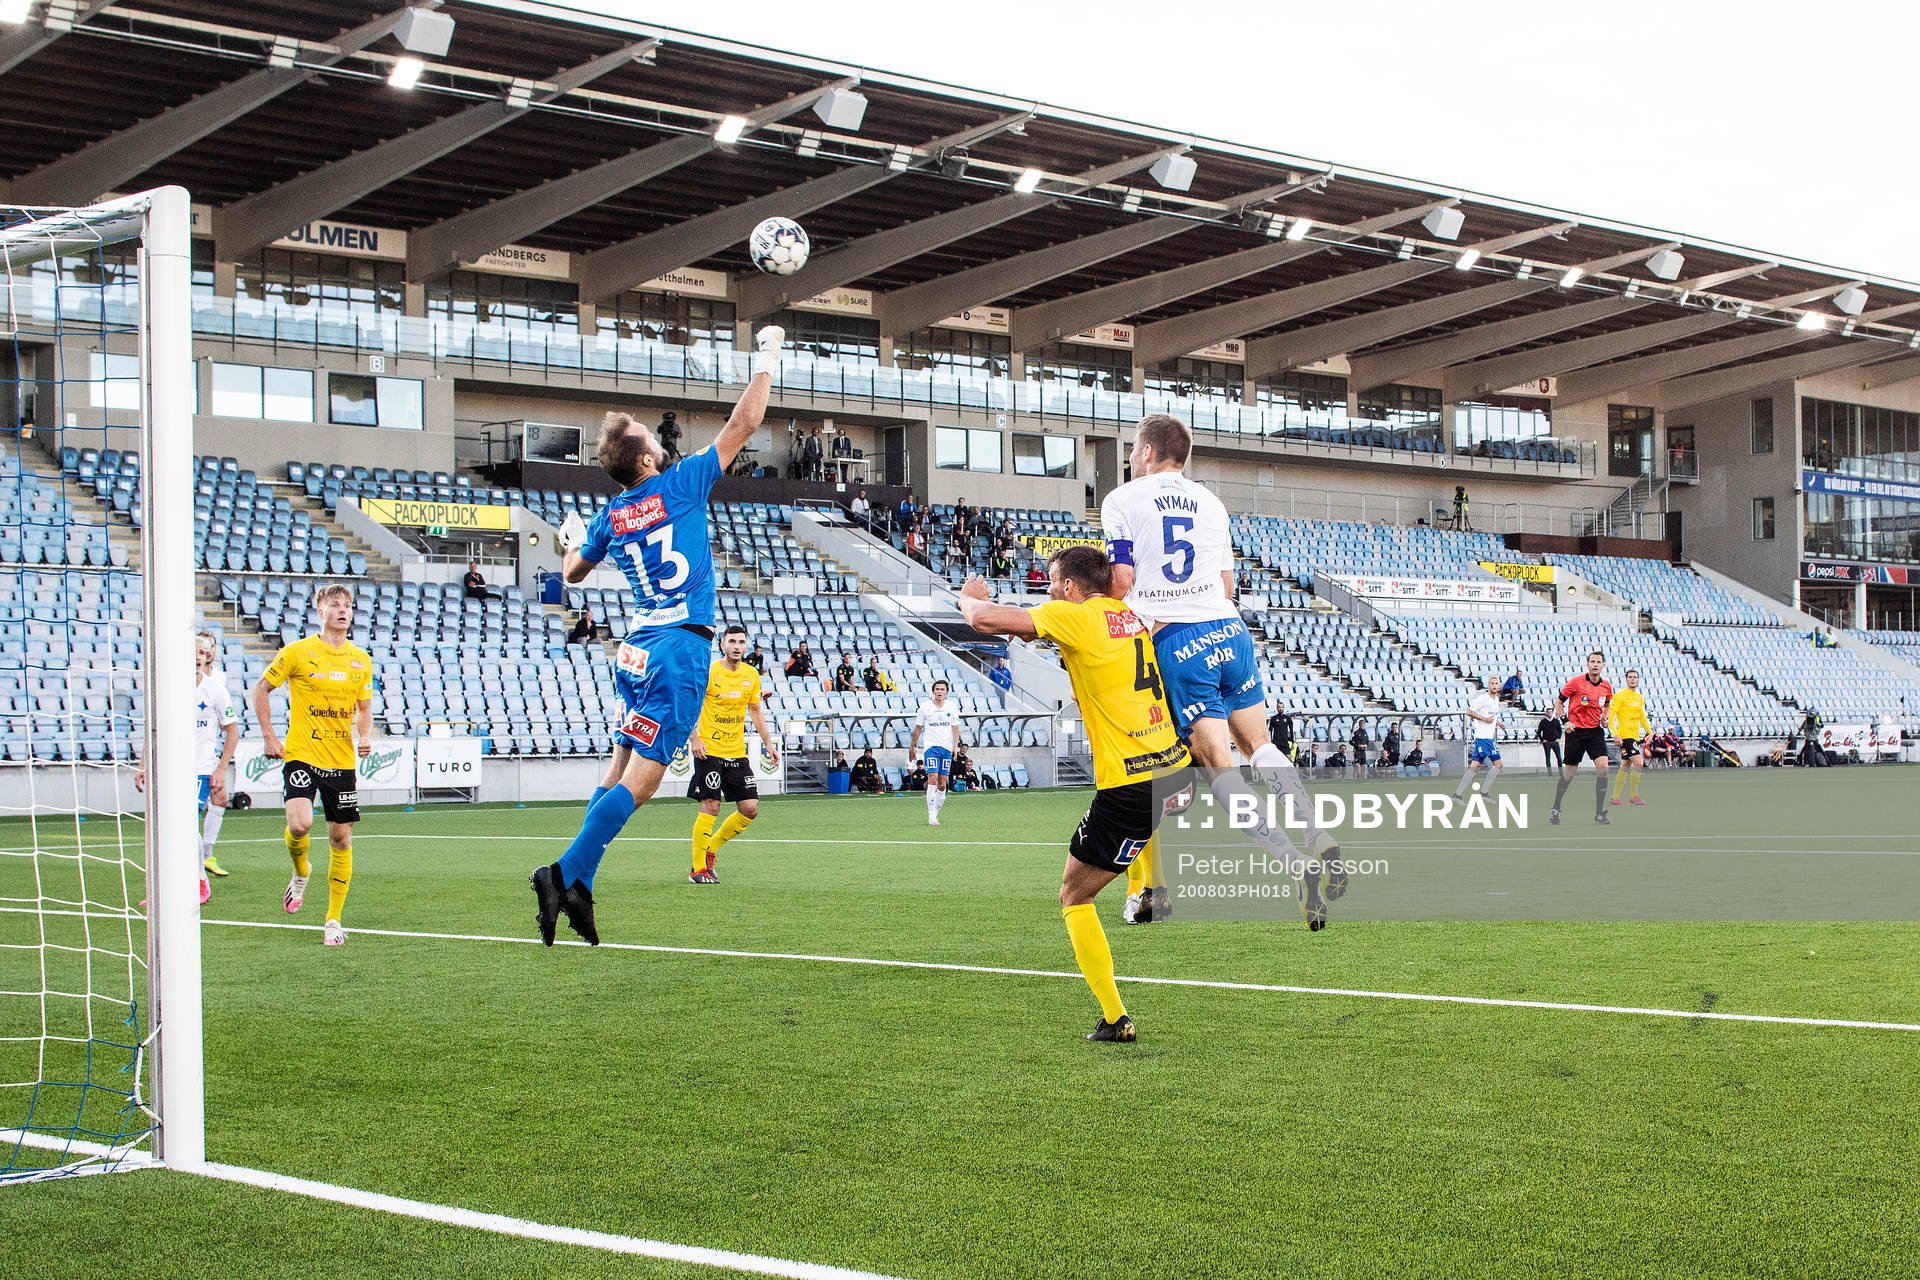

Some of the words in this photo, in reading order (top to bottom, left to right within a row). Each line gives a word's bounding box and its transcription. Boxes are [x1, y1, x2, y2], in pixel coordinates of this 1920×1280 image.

[286, 222, 378, 251] OLMEN
[488, 248, 547, 262] UNDBERGS
[658, 274, 705, 287] ottholmen
[1113, 328, 1130, 338] MAXI
[565, 453, 579, 461] min
[394, 502, 478, 526] PACKOPLOCK
[611, 498, 661, 521] marhing
[1154, 495, 1198, 514] NYMAN
[614, 522, 625, 533] on
[1162, 515, 1196, 584] 5
[624, 523, 690, 597] 13
[1816, 566, 1834, 578] pepsi
[1109, 625, 1124, 635] on
[1173, 621, 1244, 664] MÅNSSON
[1133, 638, 1163, 700] 4
[623, 718, 655, 737] XTRA
[427, 762, 472, 773] TURO
